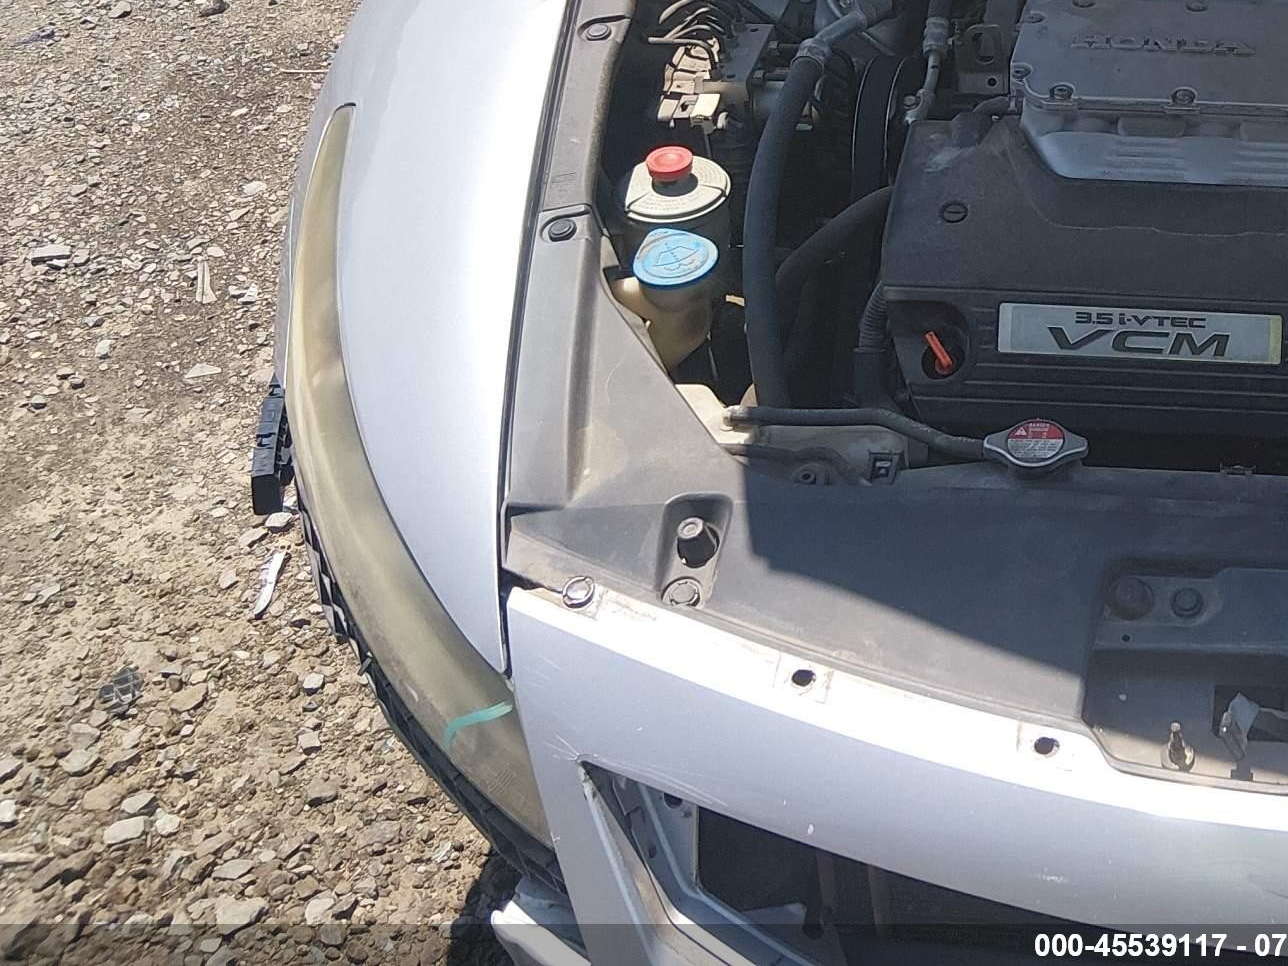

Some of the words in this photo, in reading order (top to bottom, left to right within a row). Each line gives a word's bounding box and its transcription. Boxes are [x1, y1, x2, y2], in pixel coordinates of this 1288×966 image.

[1071, 34, 1256, 56] HONDA
[1075, 312, 1113, 325] 3.5
[1119, 313, 1206, 328] i-VTEC
[1048, 326, 1230, 357] VCM
